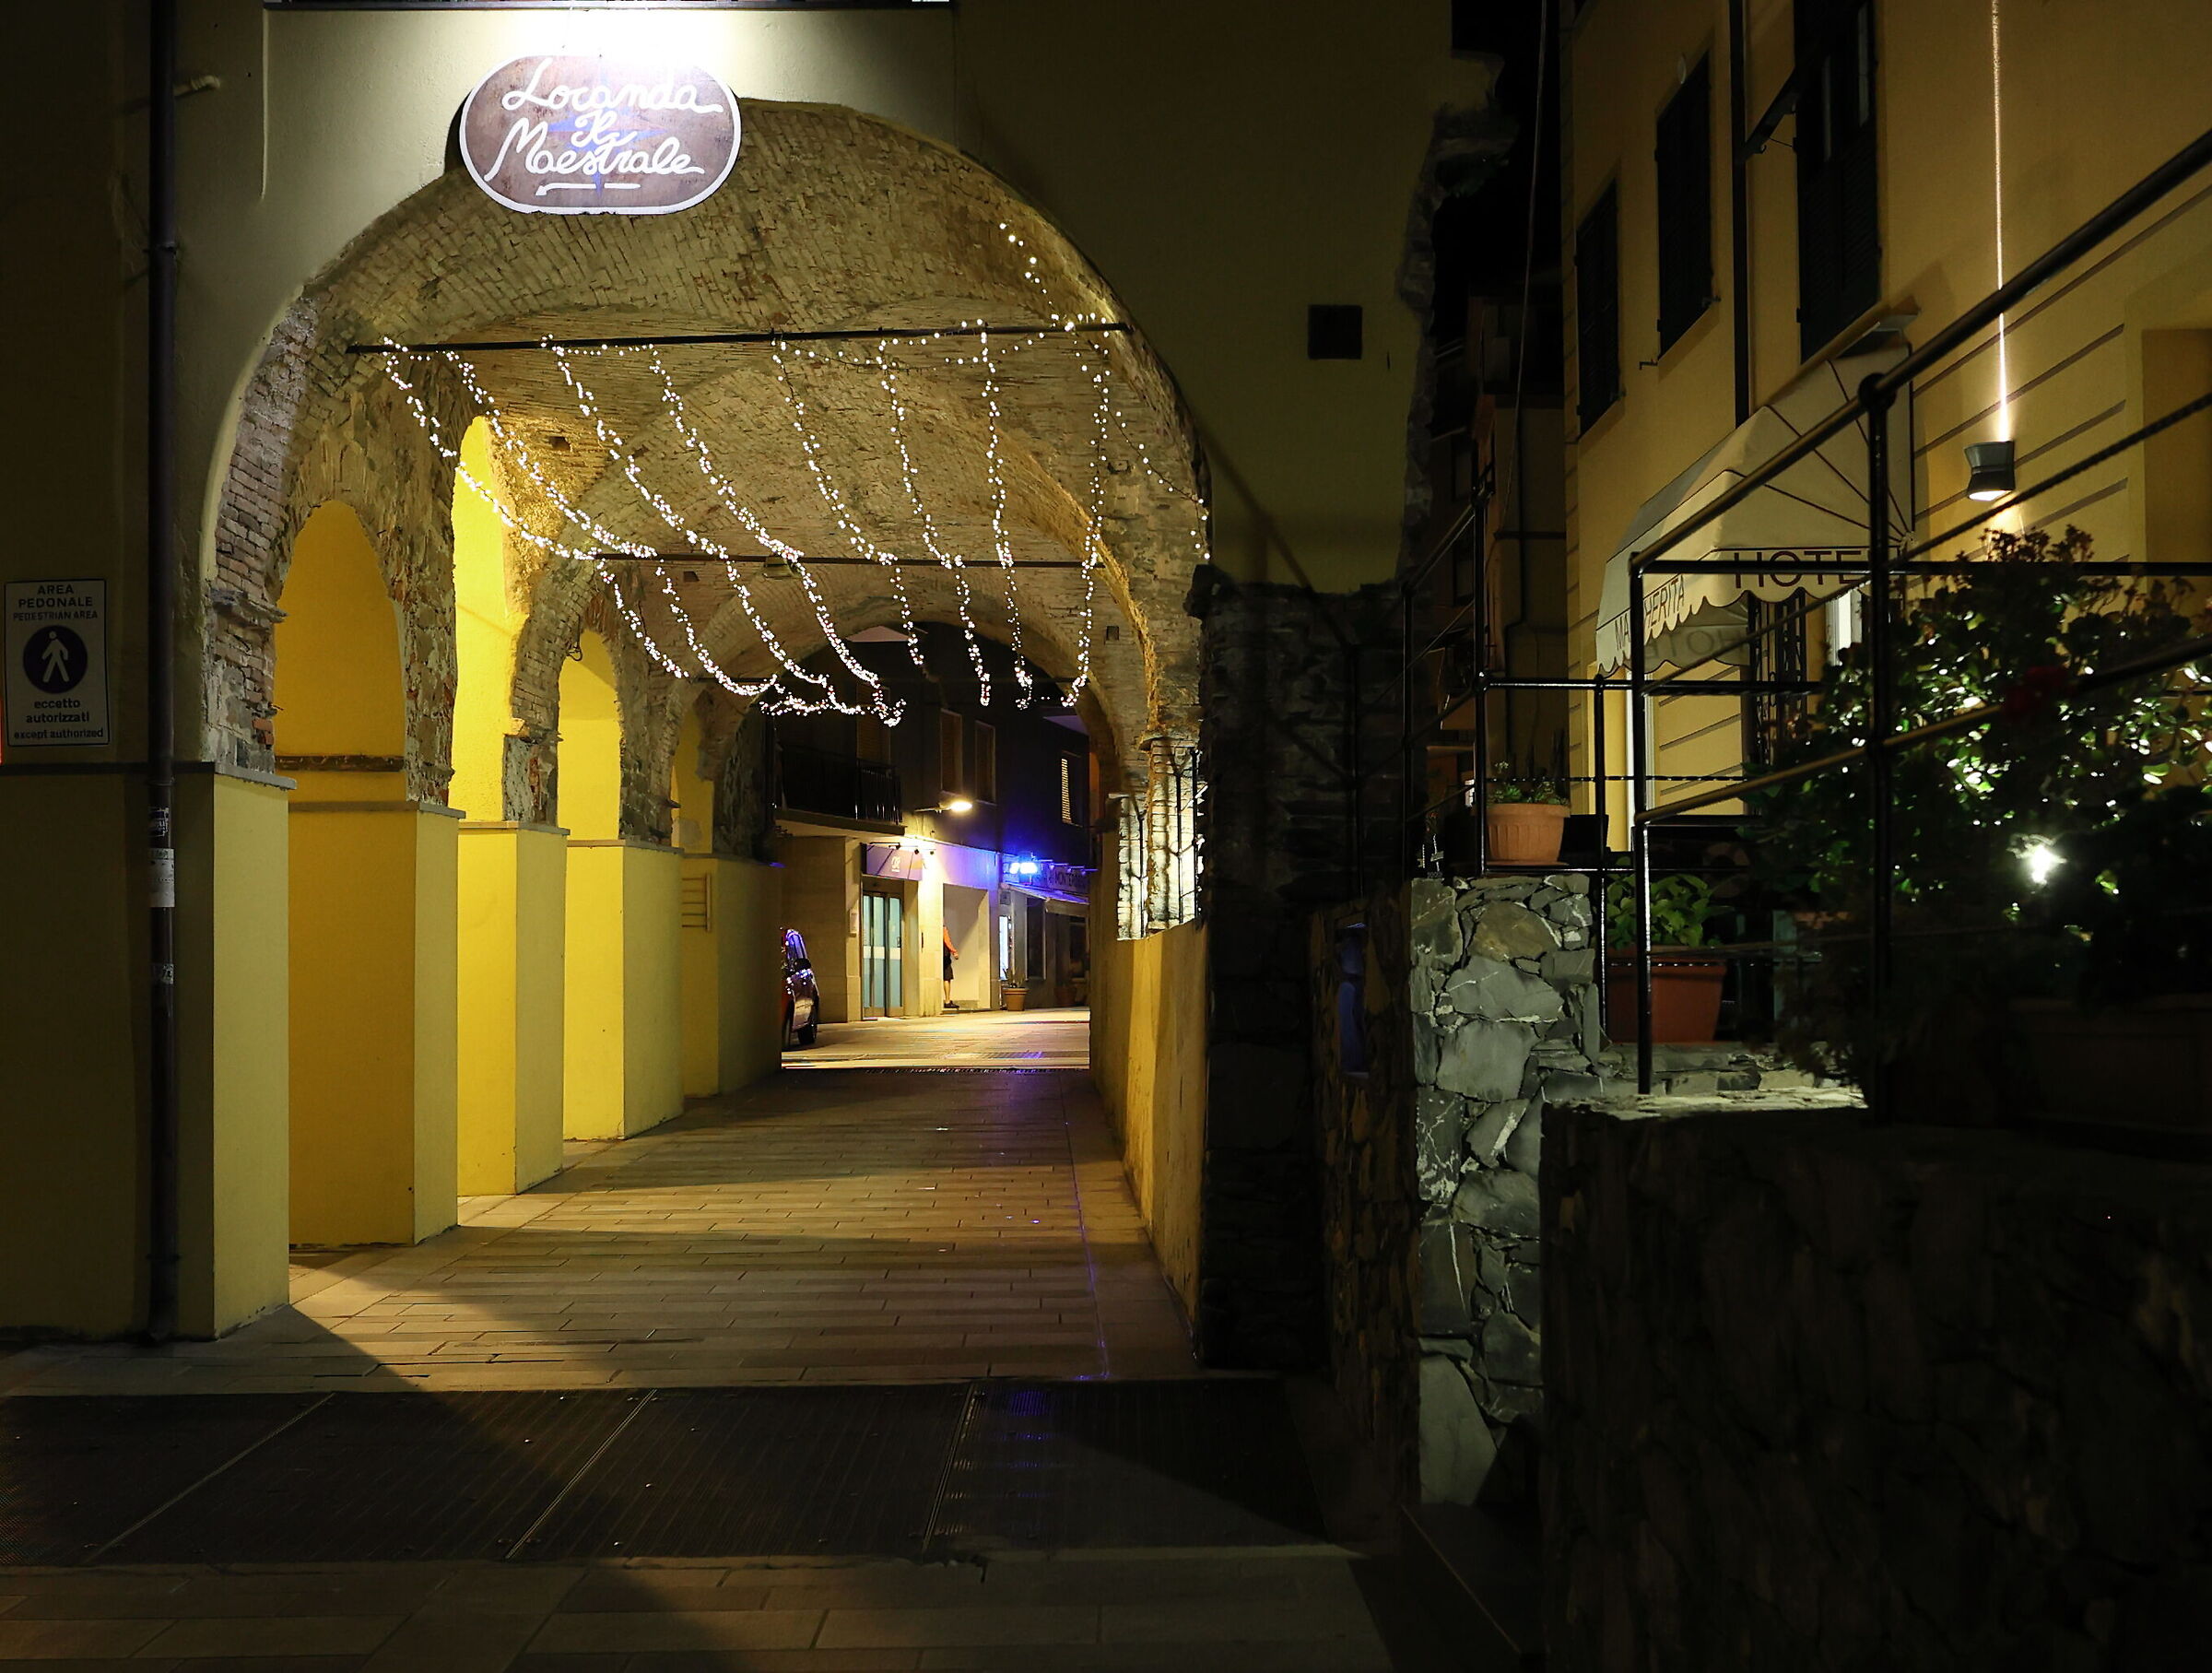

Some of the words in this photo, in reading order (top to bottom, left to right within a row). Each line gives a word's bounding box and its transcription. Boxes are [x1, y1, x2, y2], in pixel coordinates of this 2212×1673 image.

[501, 57, 724, 113] Locanda
[483, 117, 705, 183] Maestrale
[1734, 550, 1897, 588] HOTE
[37, 583, 75, 595] AREA
[18, 596, 94, 608] PEDONALE
[13, 611, 72, 621] PEDESTRIAN
[74, 610, 99, 619] AREA
[1614, 573, 1686, 651] MAHERITA
[34, 698, 81, 709] eccetto
[26, 712, 89, 724] autorizzati
[14, 729, 47, 740] except
[50, 726, 103, 738] authorized
